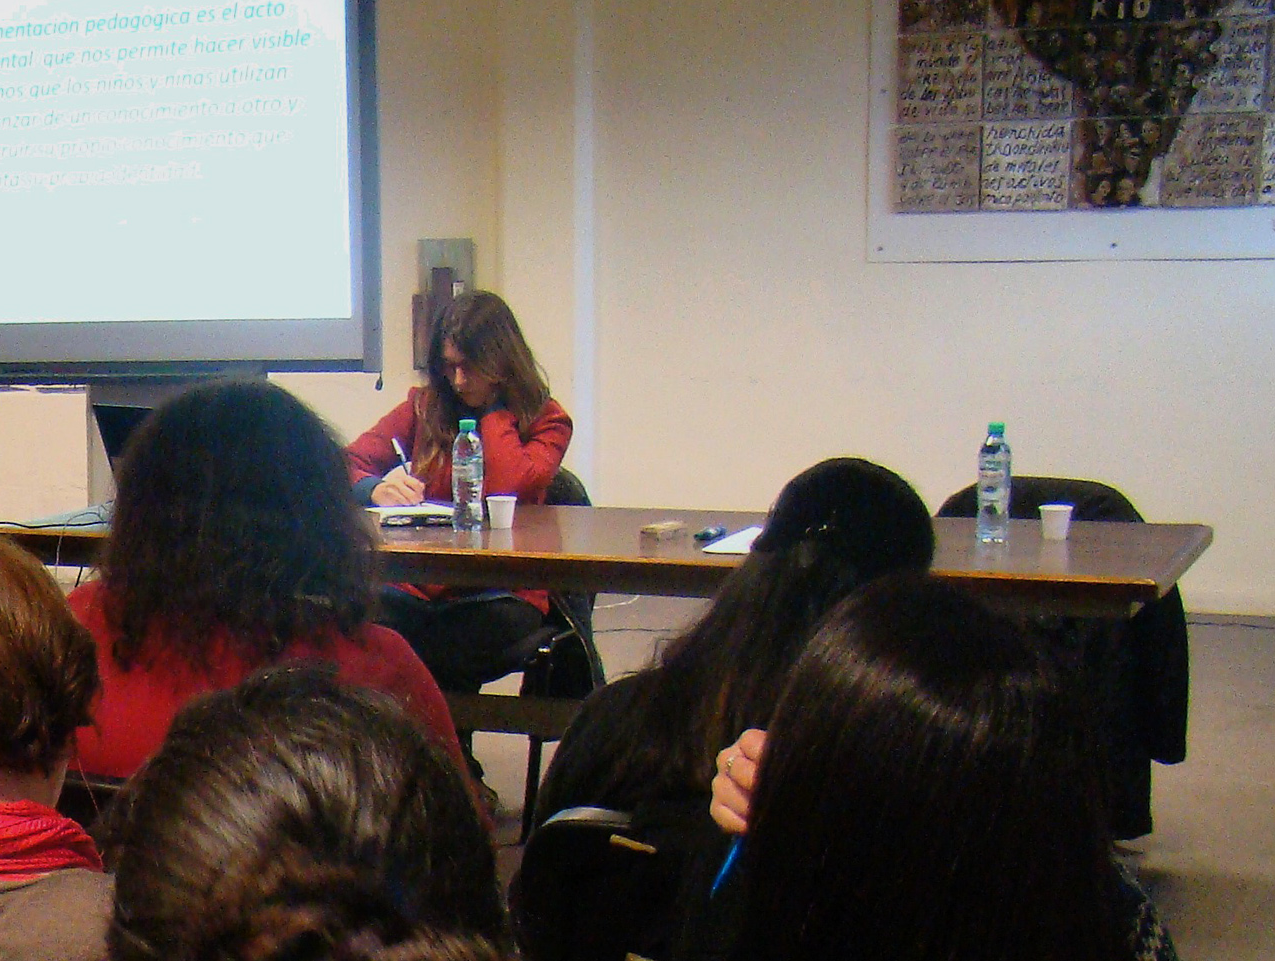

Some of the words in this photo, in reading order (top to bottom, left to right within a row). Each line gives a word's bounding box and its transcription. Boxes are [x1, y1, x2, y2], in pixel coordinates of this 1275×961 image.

[196, 8, 215, 23] es
[222, 2, 238, 20] el
[244, 1, 285, 19] acto
[43, 50, 75, 68] que
[81, 47, 111, 63] nos
[116, 40, 188, 62] permite
[195, 37, 246, 54] hacer
[252, 28, 311, 50] visible
[29, 82, 61, 99] que
[67, 77, 90, 94] los
[96, 73, 143, 92] niños
[219, 64, 287, 84] utilizan
[43, 109, 61, 126] de
[242, 98, 283, 114] otro
